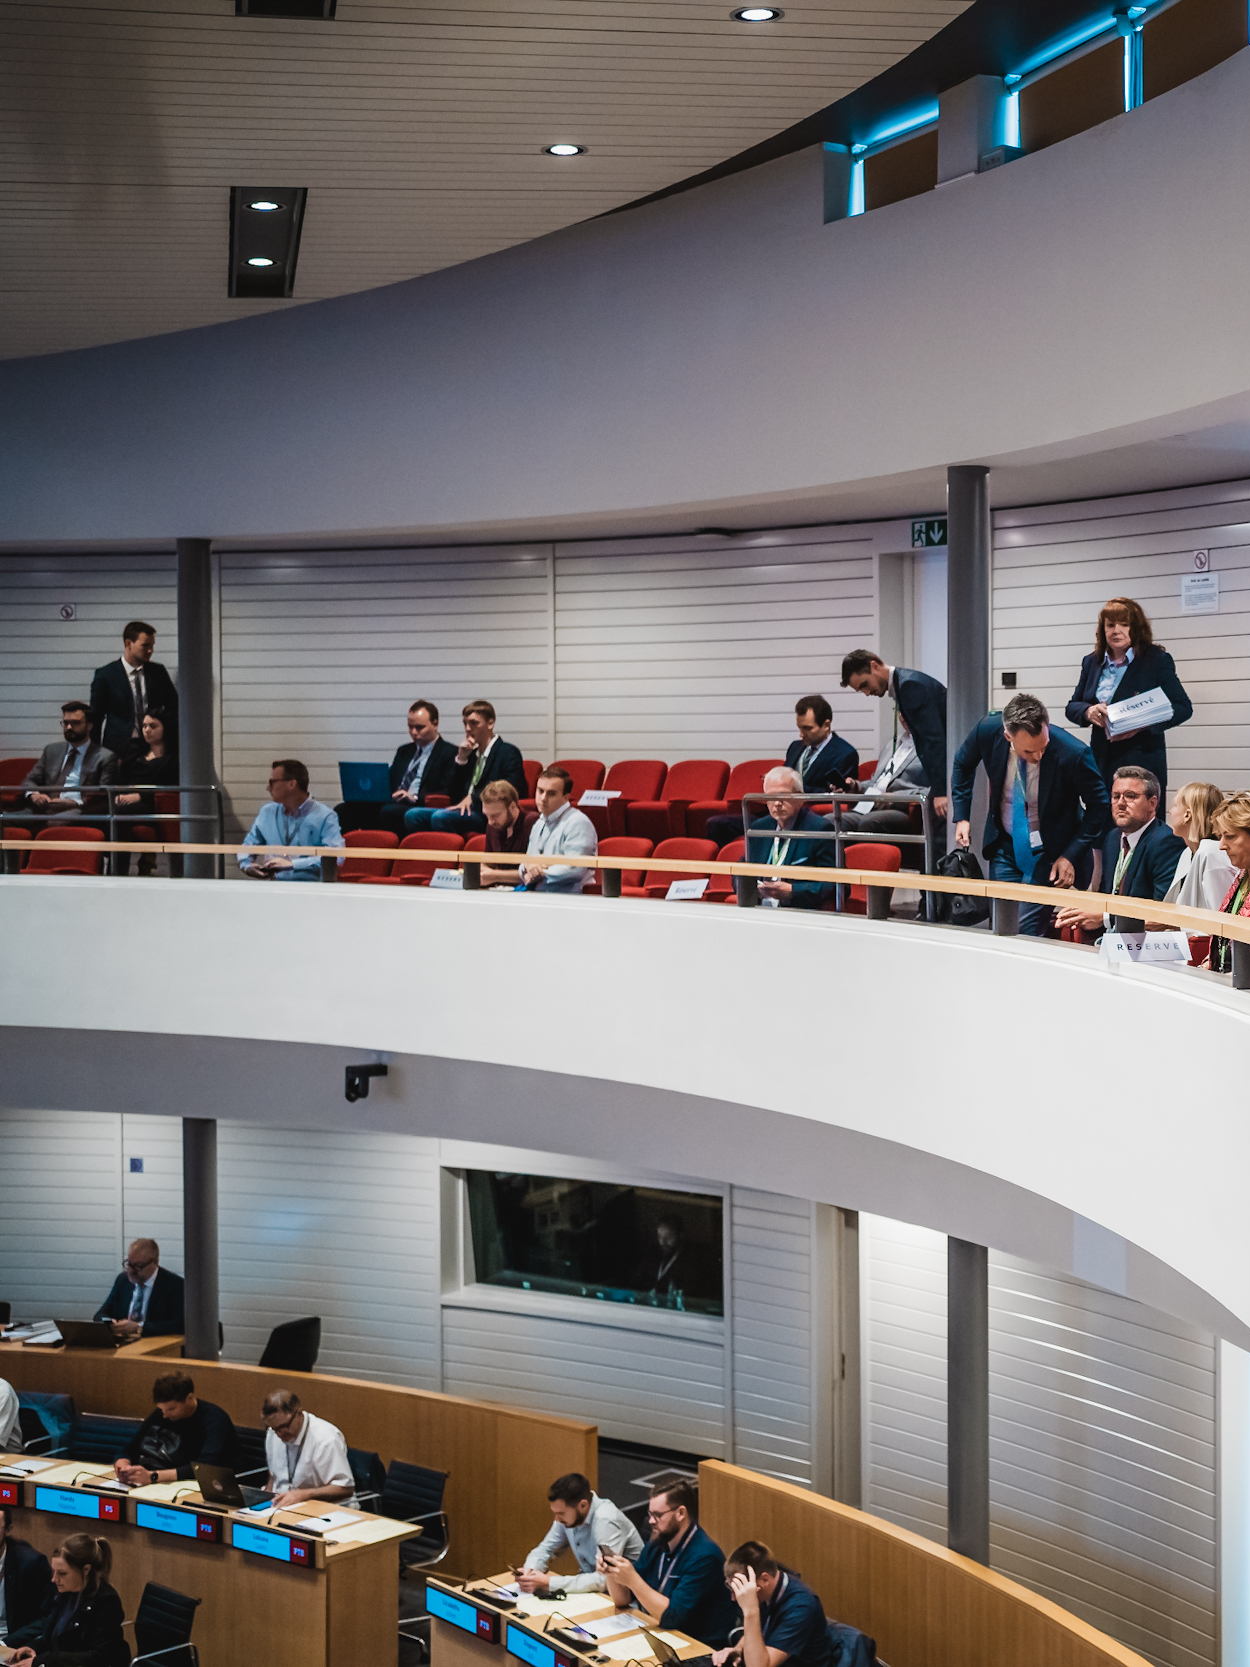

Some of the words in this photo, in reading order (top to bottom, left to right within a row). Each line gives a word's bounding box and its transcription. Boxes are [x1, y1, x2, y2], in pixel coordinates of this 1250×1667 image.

[1119, 696, 1154, 713] Réservé
[1117, 943, 1180, 951] RESERVE
[2, 1489, 11, 1498] PS
[60, 1495, 75, 1503] Hardy
[104, 1504, 113, 1513] PS
[293, 1547, 305, 1557] PTB
[479, 1619, 490, 1631] PTB
